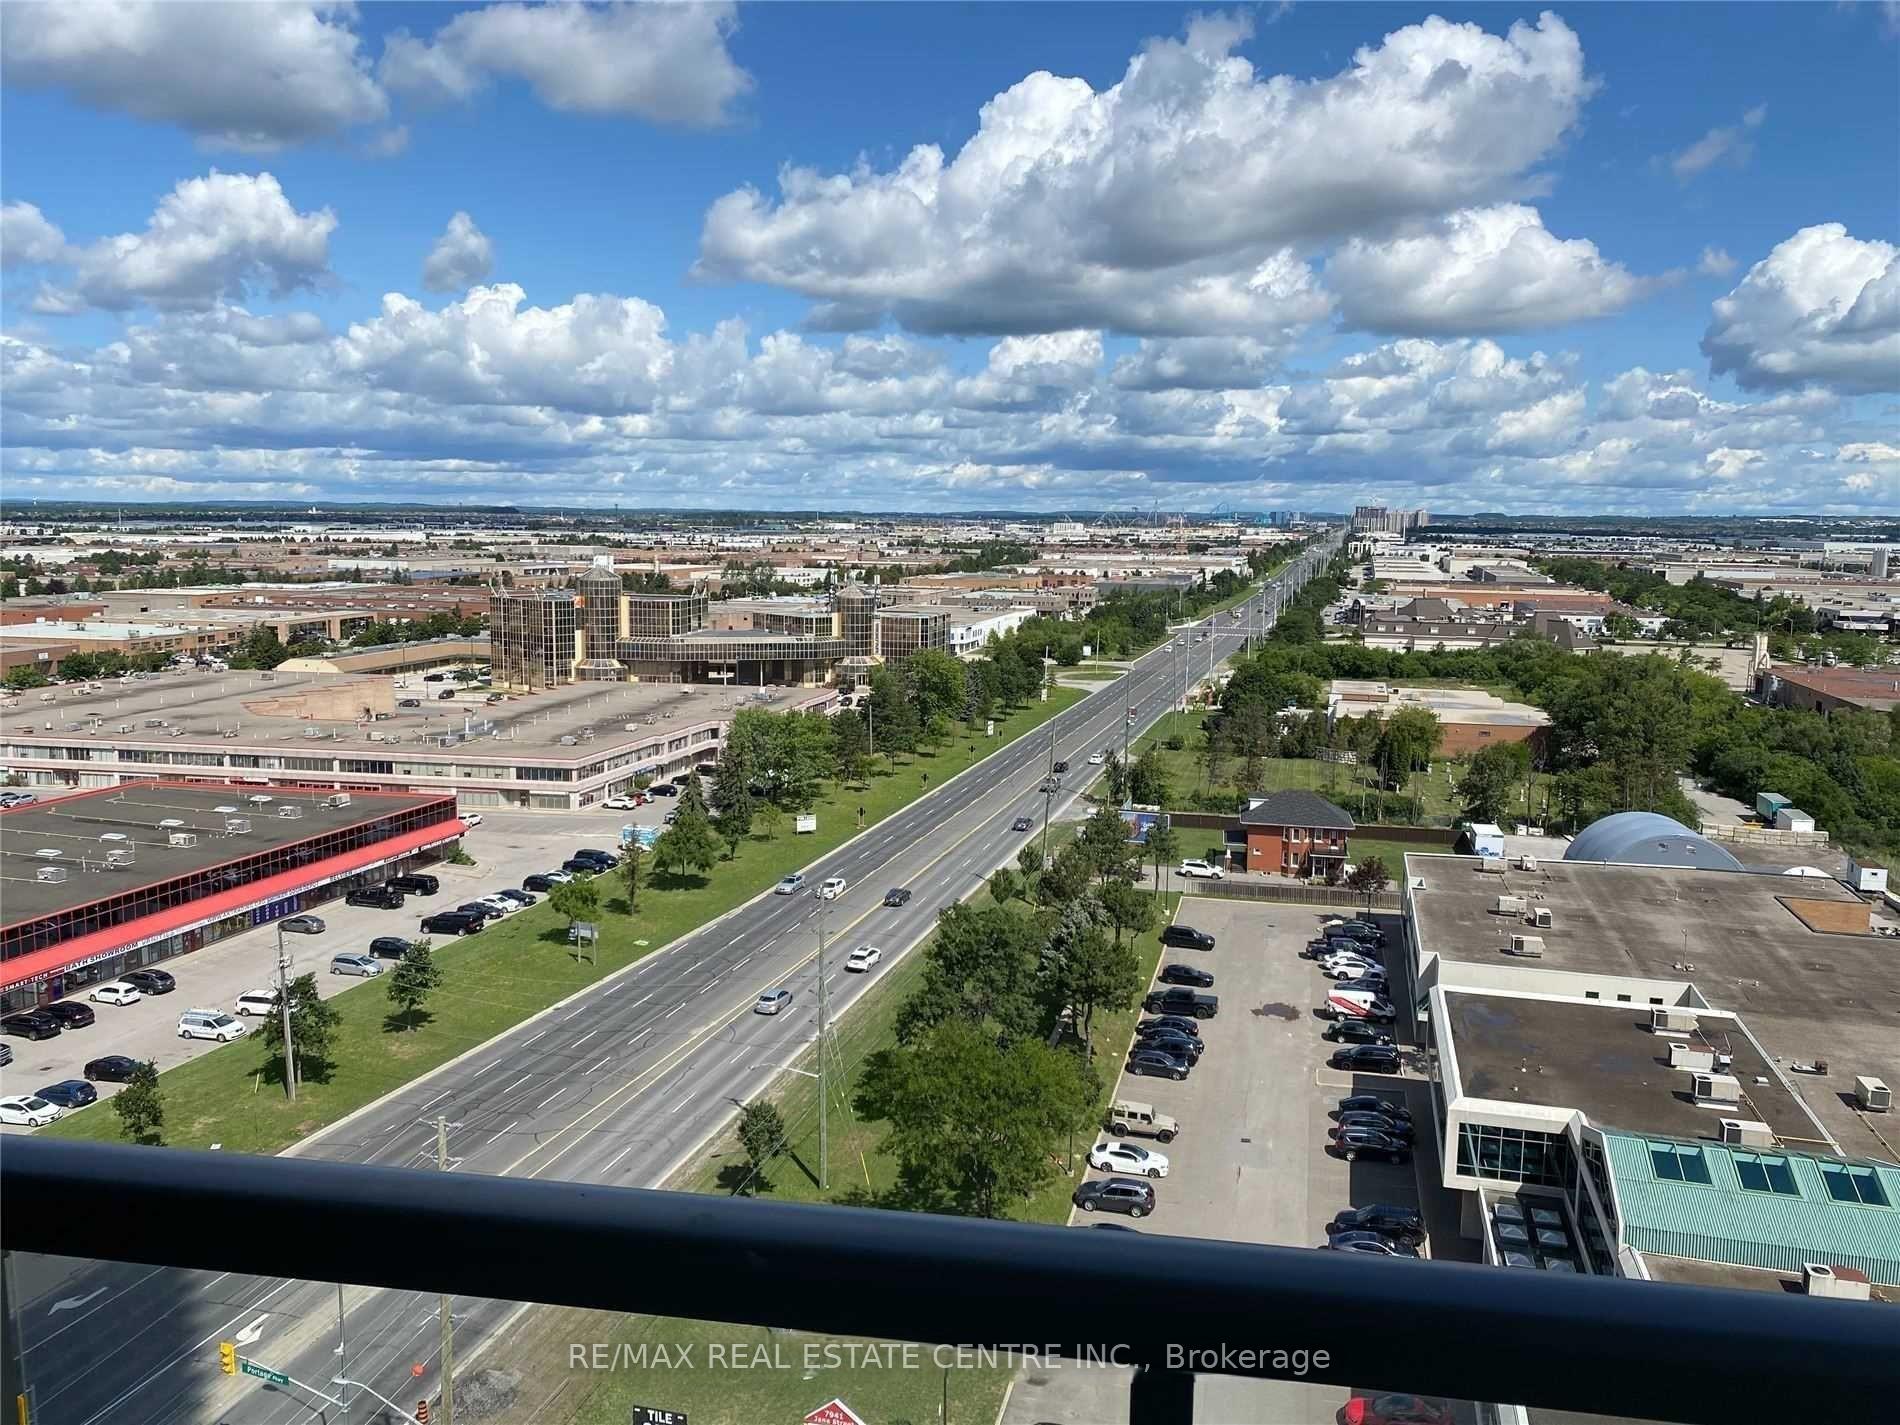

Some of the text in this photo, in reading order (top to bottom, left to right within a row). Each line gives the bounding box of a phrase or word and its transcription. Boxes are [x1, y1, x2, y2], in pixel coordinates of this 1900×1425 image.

[90, 942, 139, 963] SHOWROOM
[5, 972, 48, 992] SMART TECH
[247, 1365, 271, 1380] Portage
[647, 1409, 673, 1424] TILE
